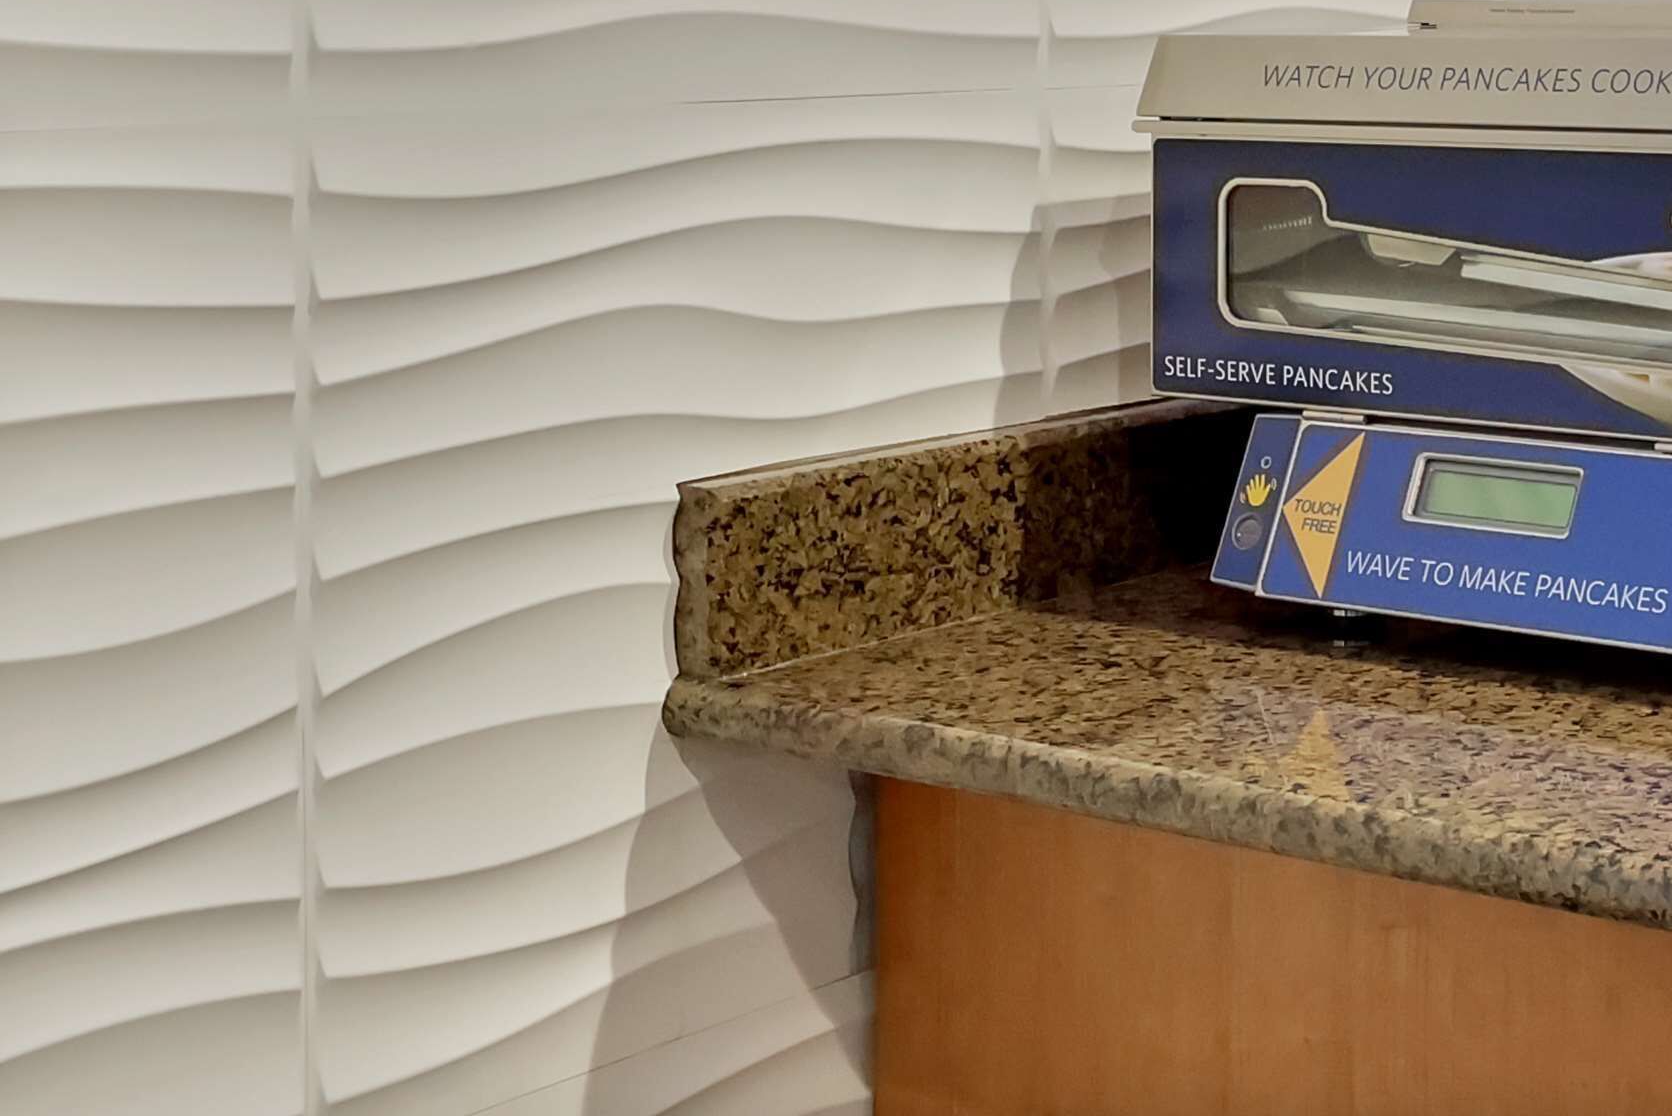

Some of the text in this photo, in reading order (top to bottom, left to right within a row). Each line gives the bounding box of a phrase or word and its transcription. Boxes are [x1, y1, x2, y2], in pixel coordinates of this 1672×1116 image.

[1262, 64, 1354, 90] WATCH
[1363, 65, 1433, 91] YOUR
[1439, 66, 1582, 93] PANCAKES
[1164, 355, 1393, 395] SELF-SERVE PANCAKES
[1294, 498, 1342, 517] TOUCH
[1301, 517, 1337, 535] FREE
[1346, 550, 1669, 614] WAVE TO MAKE PANCAKES
